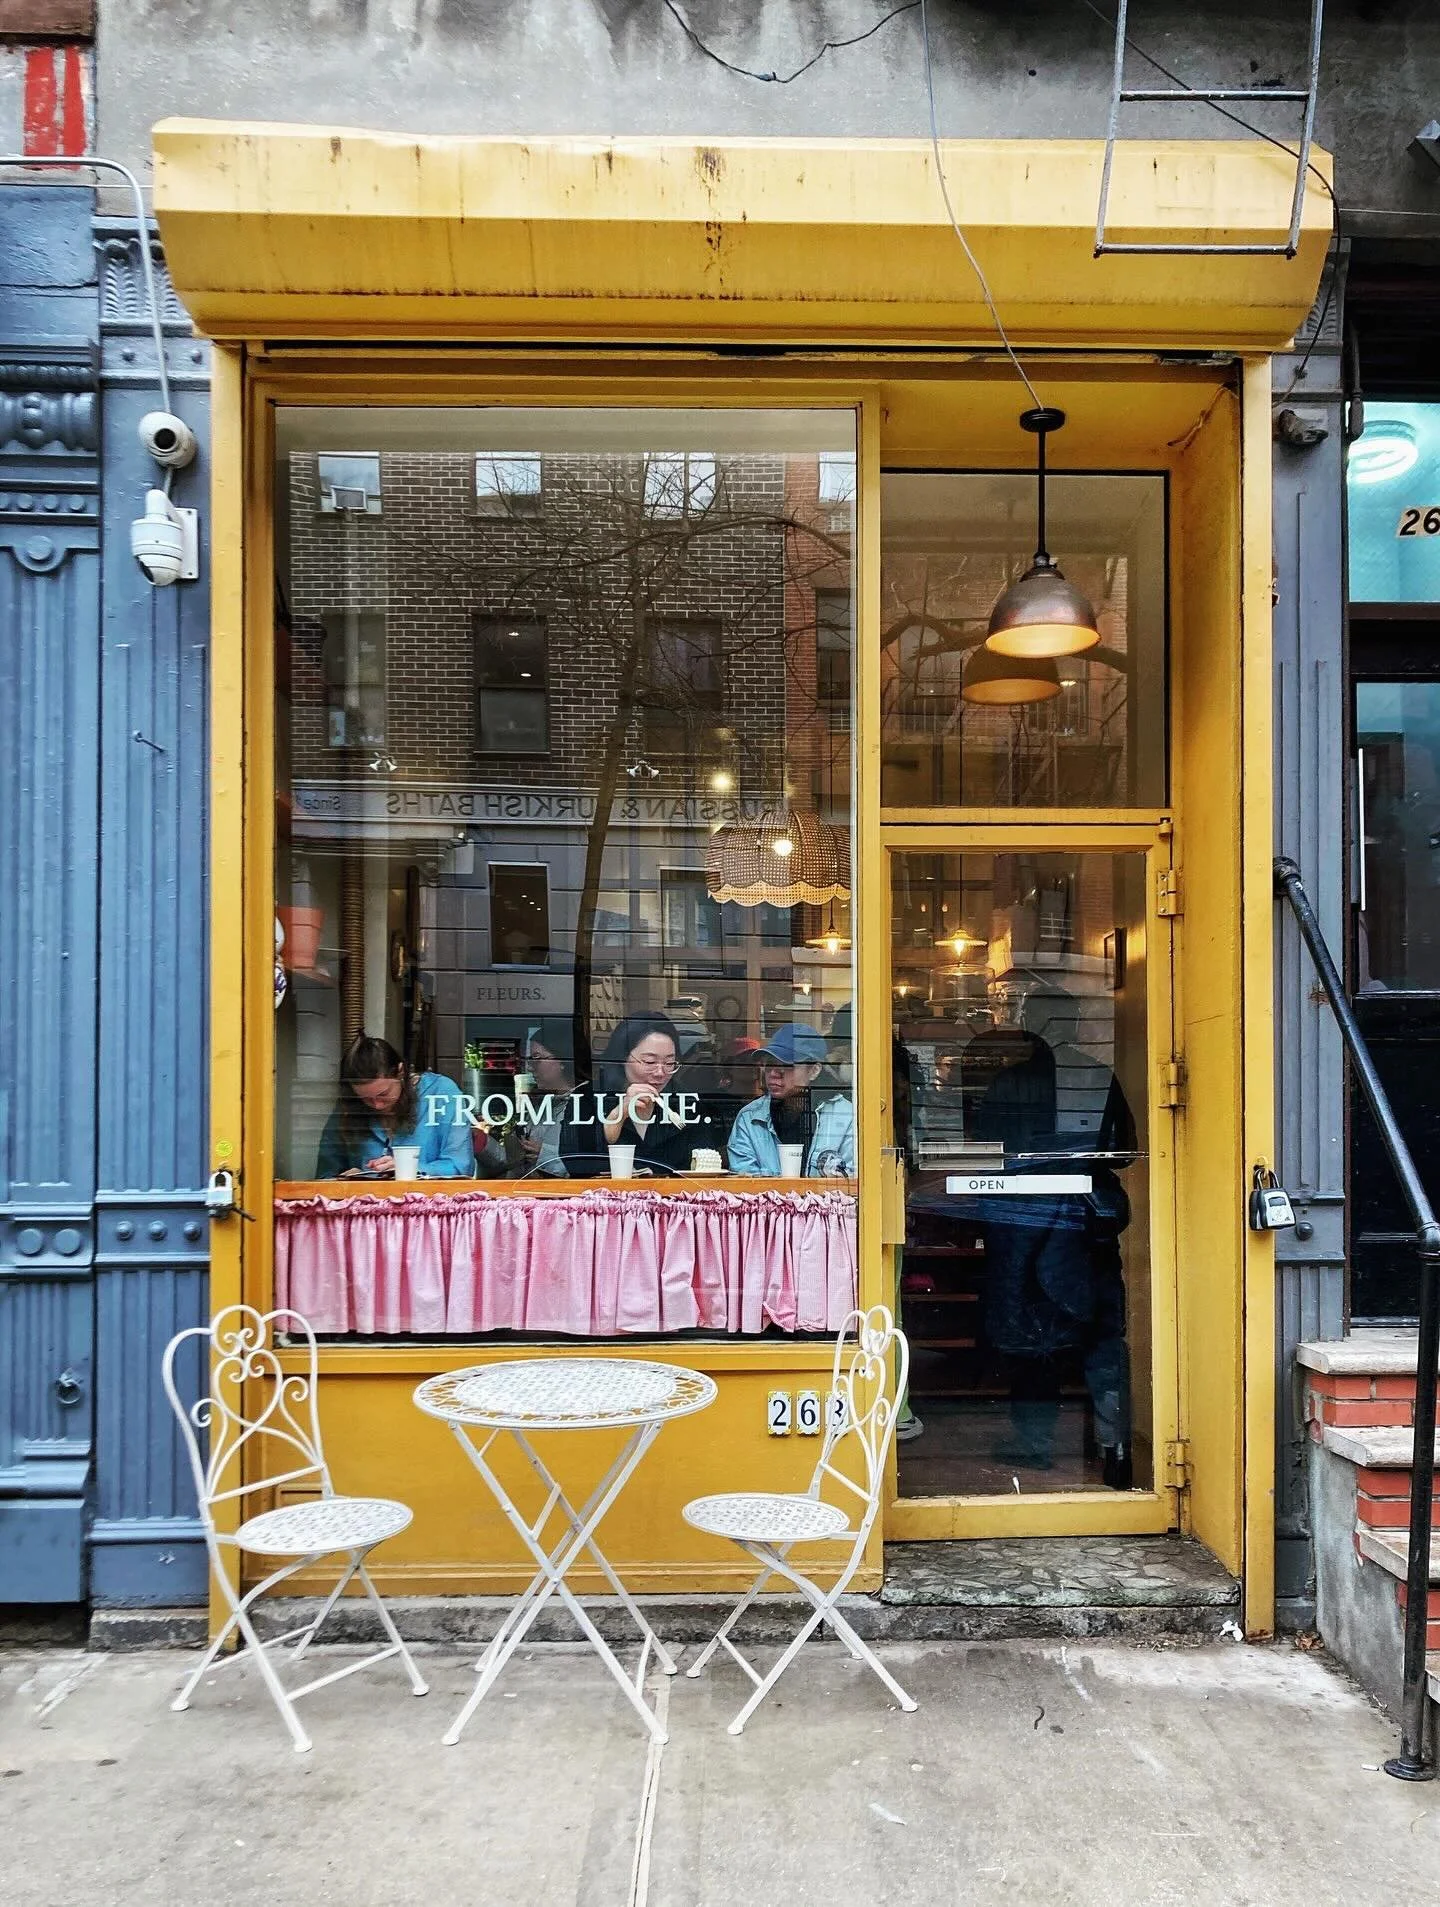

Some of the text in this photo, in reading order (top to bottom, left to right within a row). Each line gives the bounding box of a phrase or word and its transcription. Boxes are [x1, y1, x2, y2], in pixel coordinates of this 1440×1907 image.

[477, 987, 546, 1001] FLEURS.
[424, 1092, 712, 1126] FROM LUCIE.
[968, 1180, 1005, 1190] OPEN
